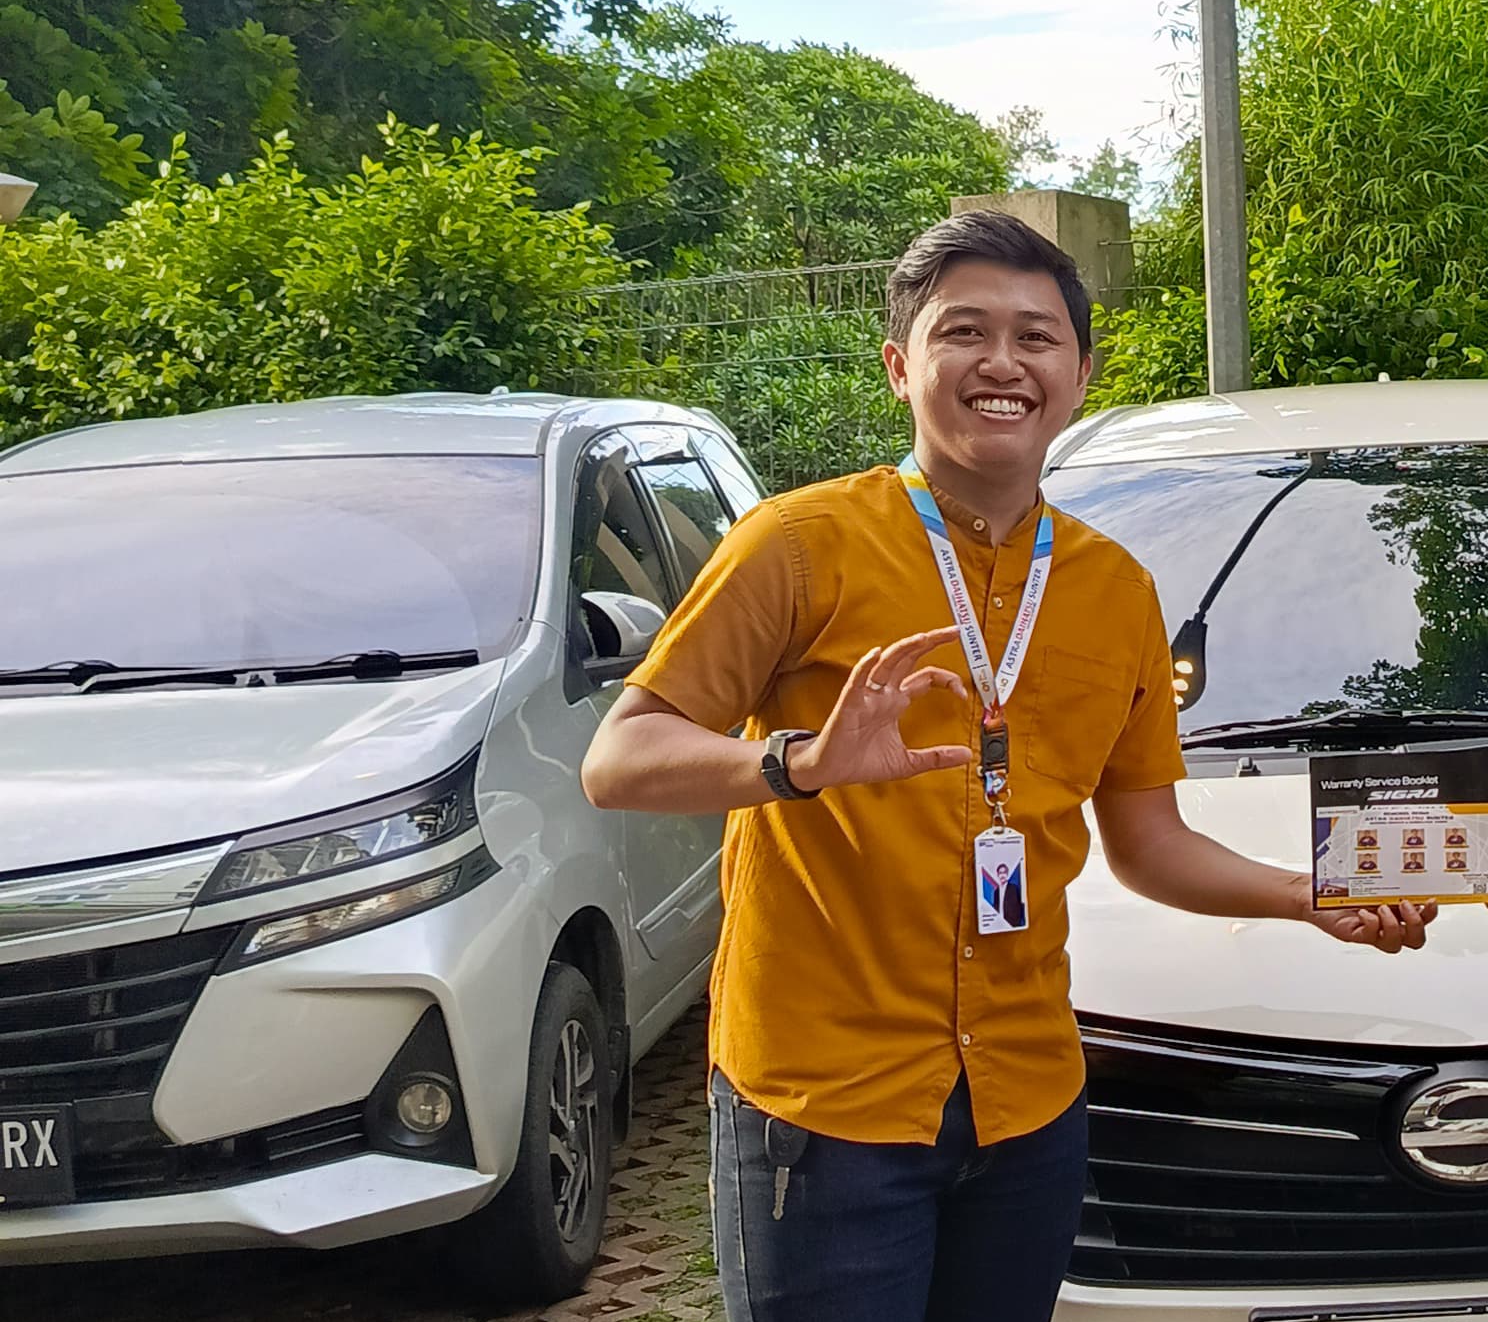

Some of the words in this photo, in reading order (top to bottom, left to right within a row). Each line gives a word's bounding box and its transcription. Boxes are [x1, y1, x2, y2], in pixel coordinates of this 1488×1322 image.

[940, 549, 957, 579] ASTRA
[950, 580, 970, 625] DAIHATSU
[964, 626, 983, 662] SUNTER
[1005, 640, 1021, 669] ASTRA
[1015, 600, 1034, 640] DAIHATSU
[1028, 568, 1043, 599] SUNTER
[1320, 779, 1364, 790] Warranty
[1364, 777, 1401, 787] Service
[1401, 775, 1439, 786] Booklet
[1367, 788, 1439, 801] SIGRA
